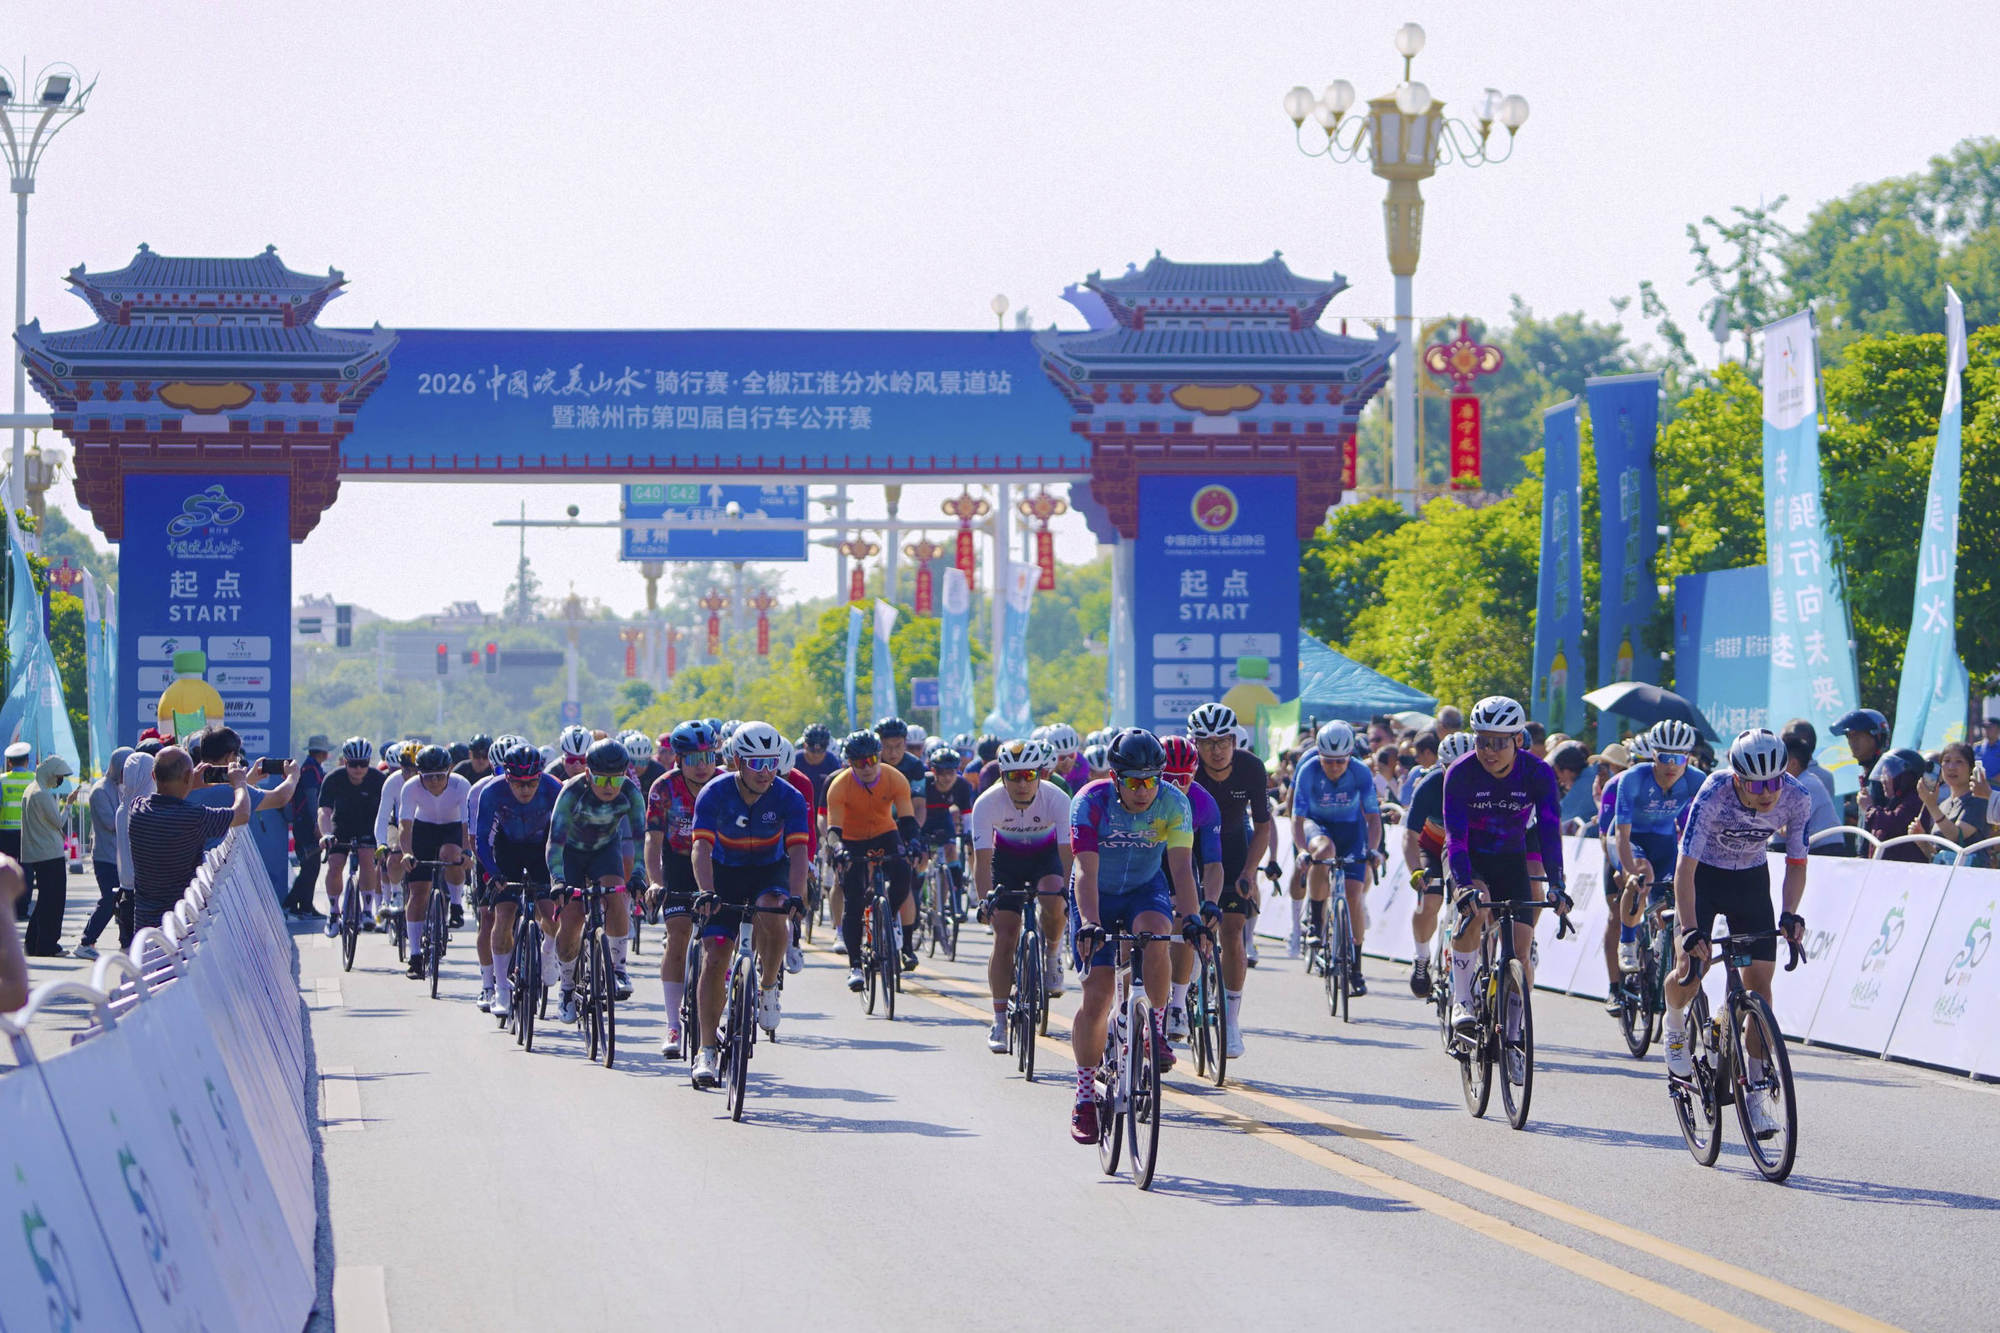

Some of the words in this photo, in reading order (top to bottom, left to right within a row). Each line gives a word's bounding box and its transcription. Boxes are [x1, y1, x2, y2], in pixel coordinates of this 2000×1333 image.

[551, 405, 872, 430] 暨滁州市第四届自行车公开赛
[635, 487, 661, 499] G40
[671, 487, 697, 499] G42
[170, 570, 241, 598] 起点
[1180, 569, 1249, 597] 起点
[169, 605, 242, 621] START
[1179, 603, 1249, 620] START
[1453, 957, 1470, 970] ky
